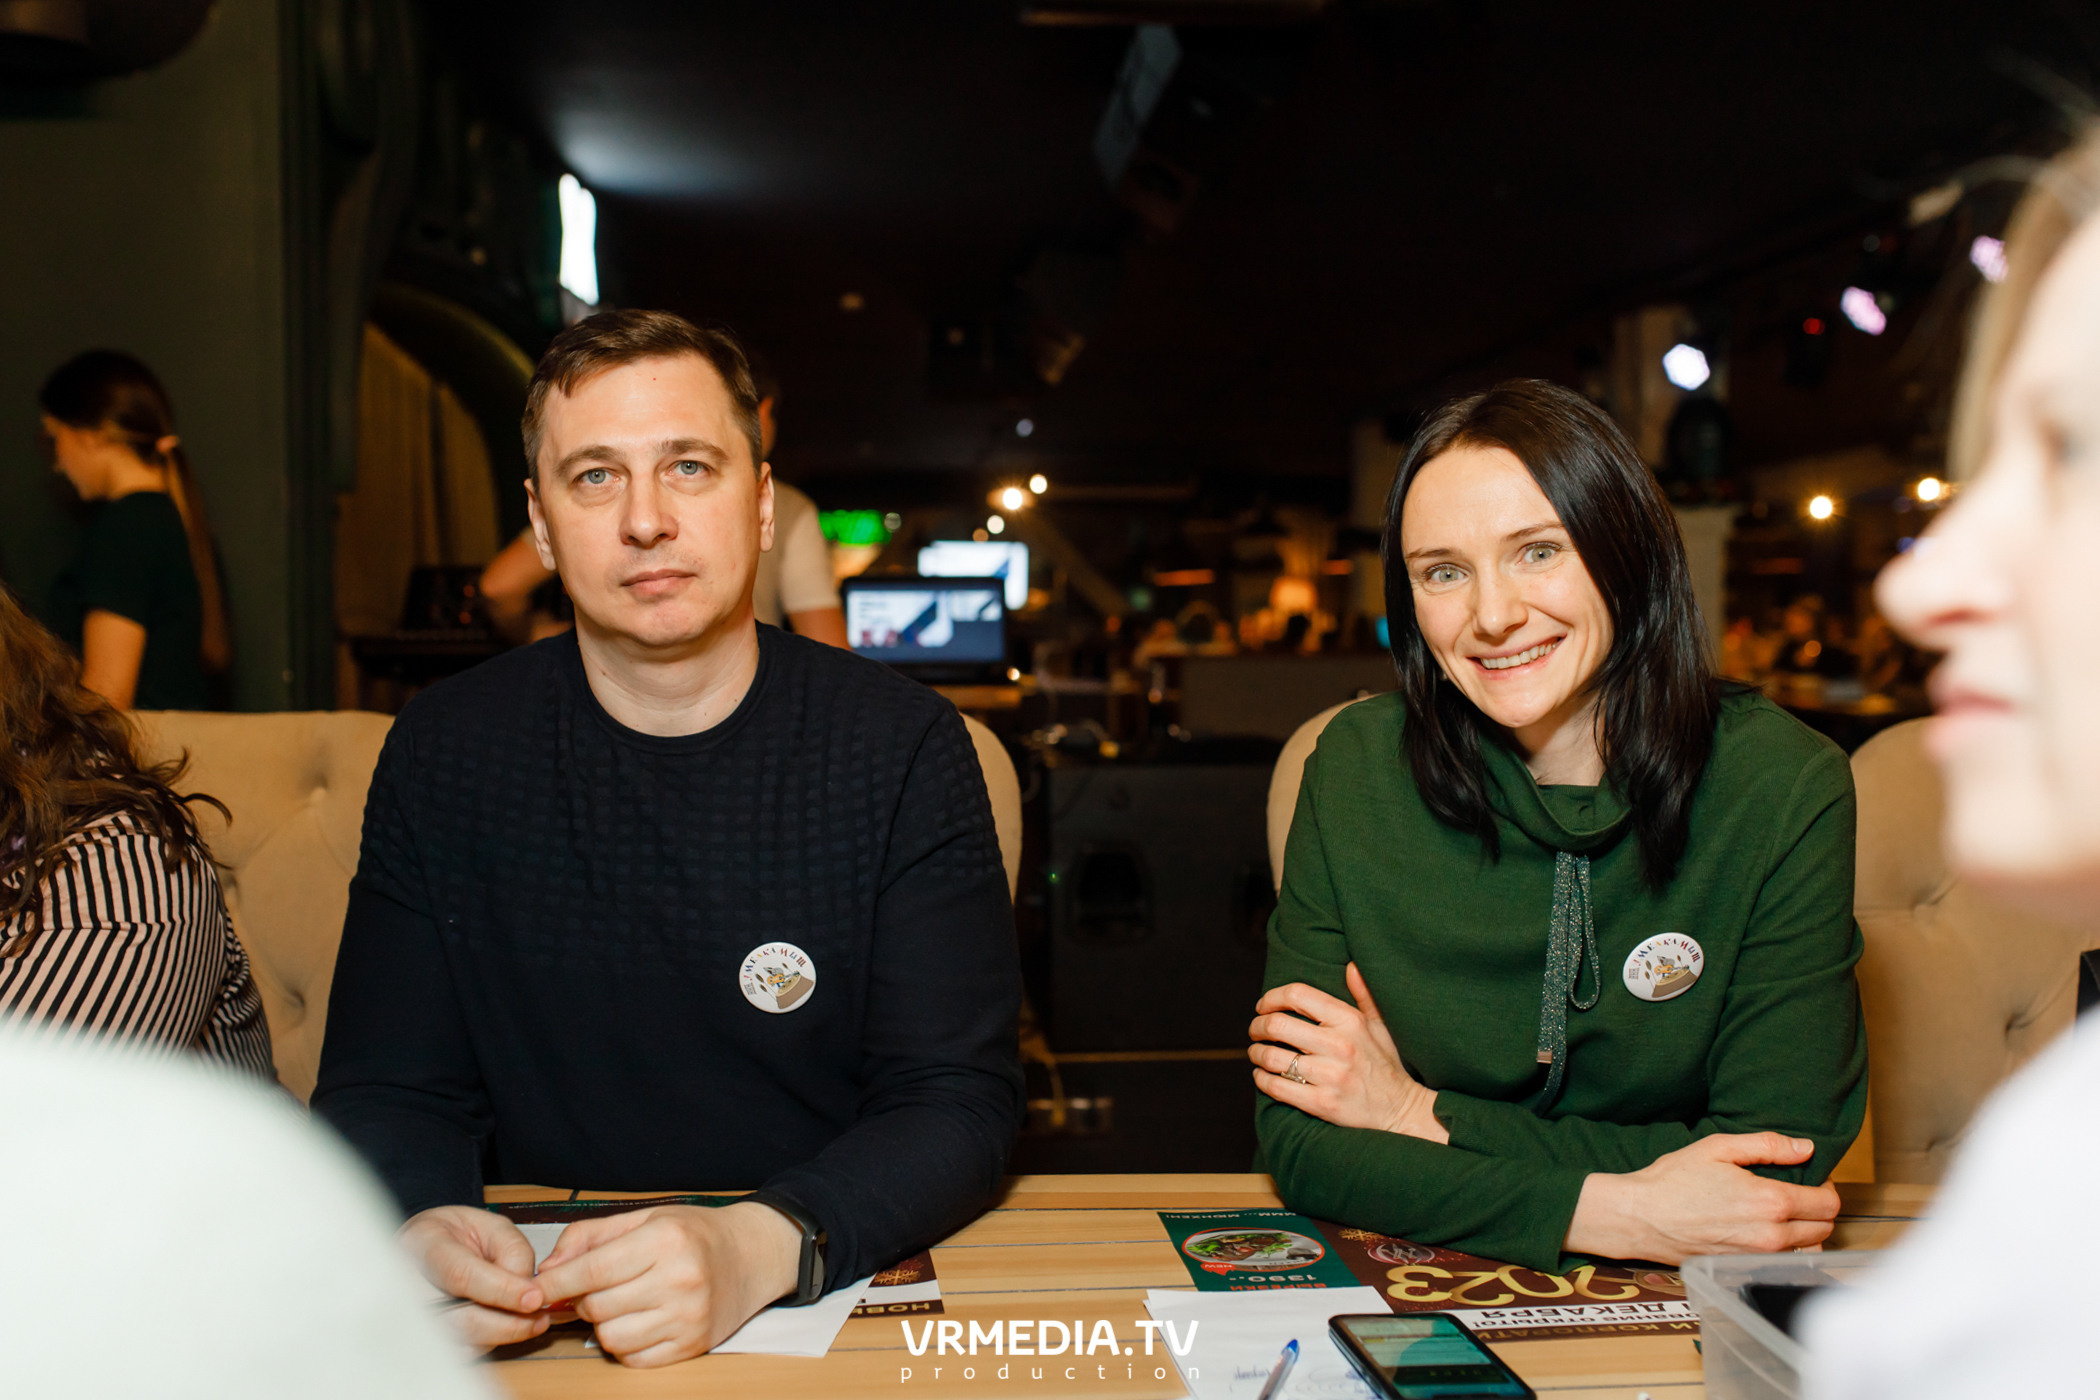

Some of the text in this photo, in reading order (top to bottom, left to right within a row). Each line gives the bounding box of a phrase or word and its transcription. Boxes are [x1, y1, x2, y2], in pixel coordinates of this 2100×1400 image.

[1386, 1264, 1642, 1308] 2023
[1480, 1301, 1668, 1320] ДЕКАБРЯ
[1602, 1311, 1701, 1323] ование
